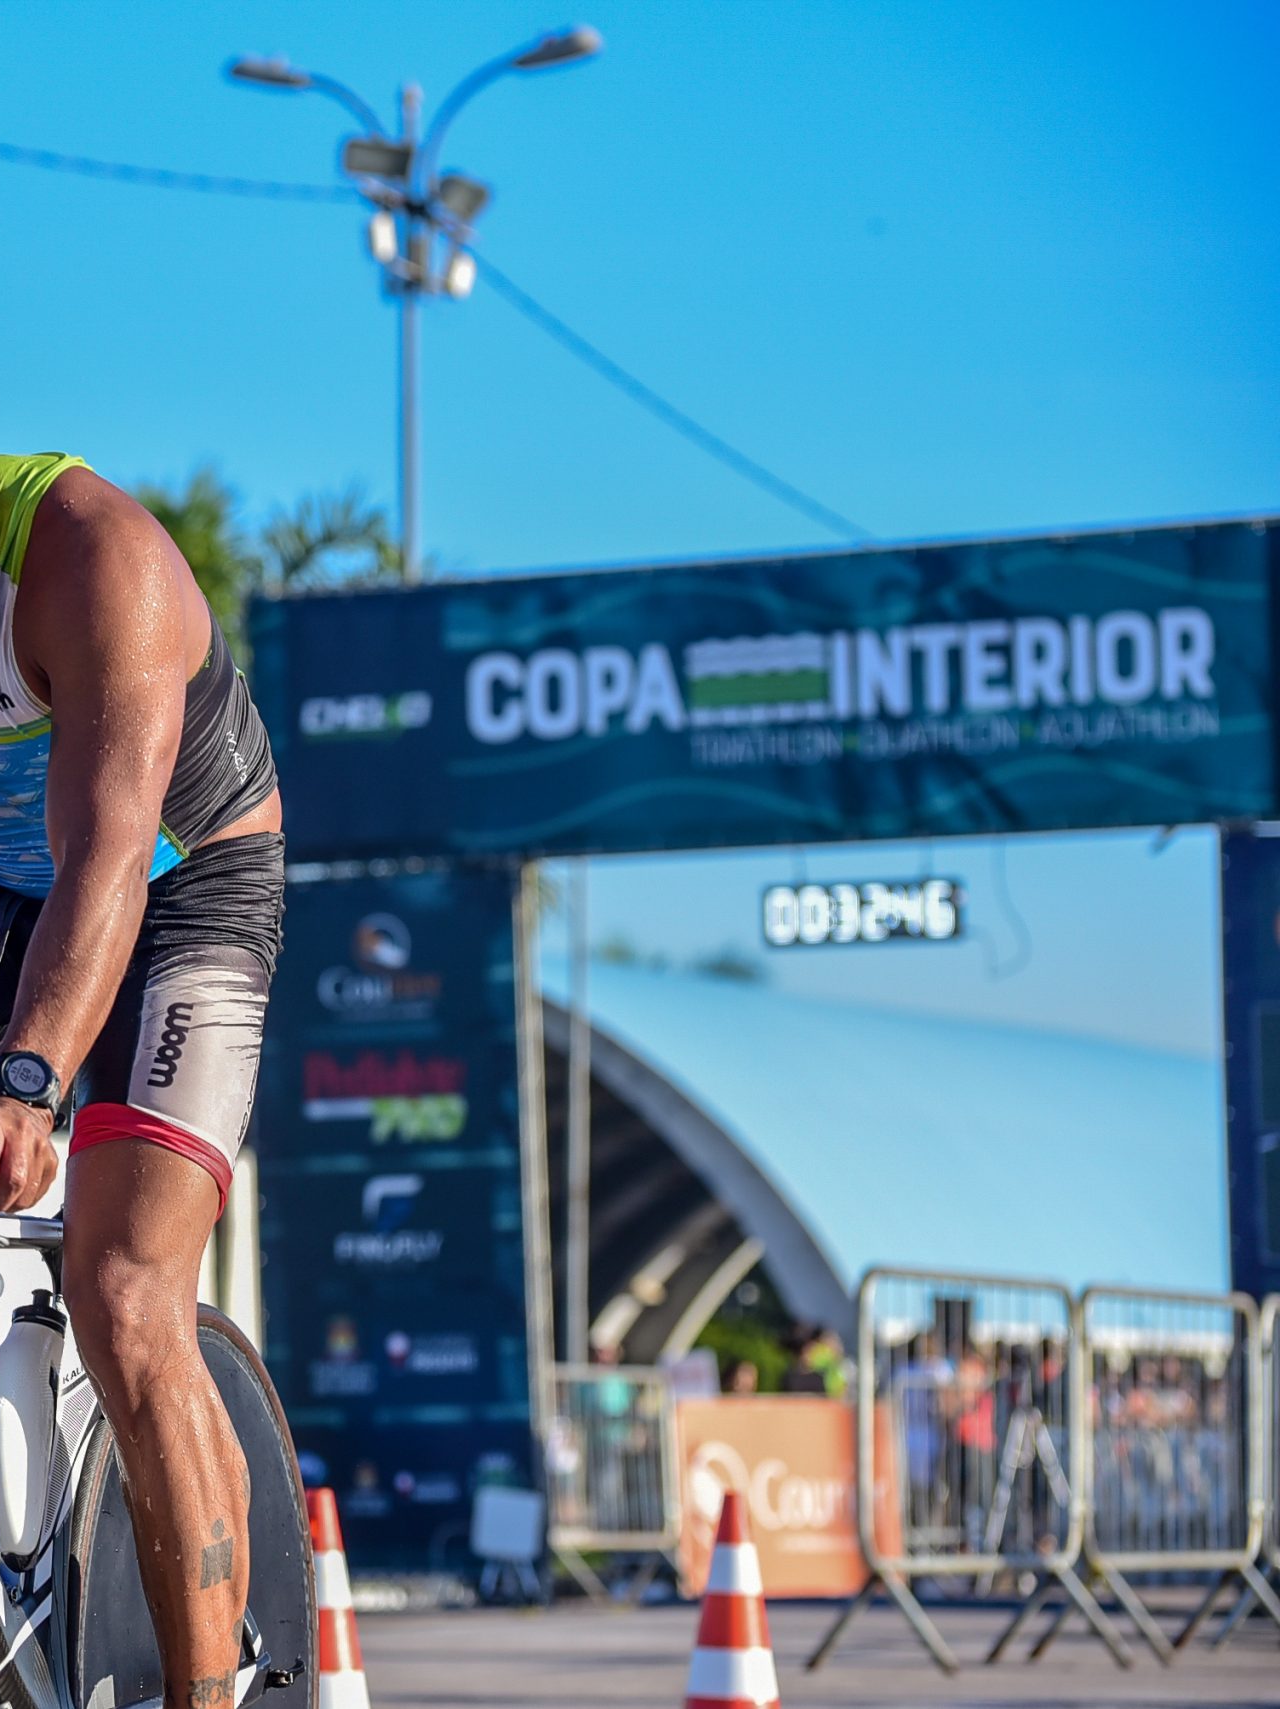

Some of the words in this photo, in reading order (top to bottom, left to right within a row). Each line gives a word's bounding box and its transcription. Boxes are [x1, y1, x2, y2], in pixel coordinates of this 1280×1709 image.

[465, 643, 687, 743] COPA
[831, 606, 1217, 720] INTERIOR
[147, 1003, 193, 1088] woom
[62, 1365, 85, 1385] KALI
